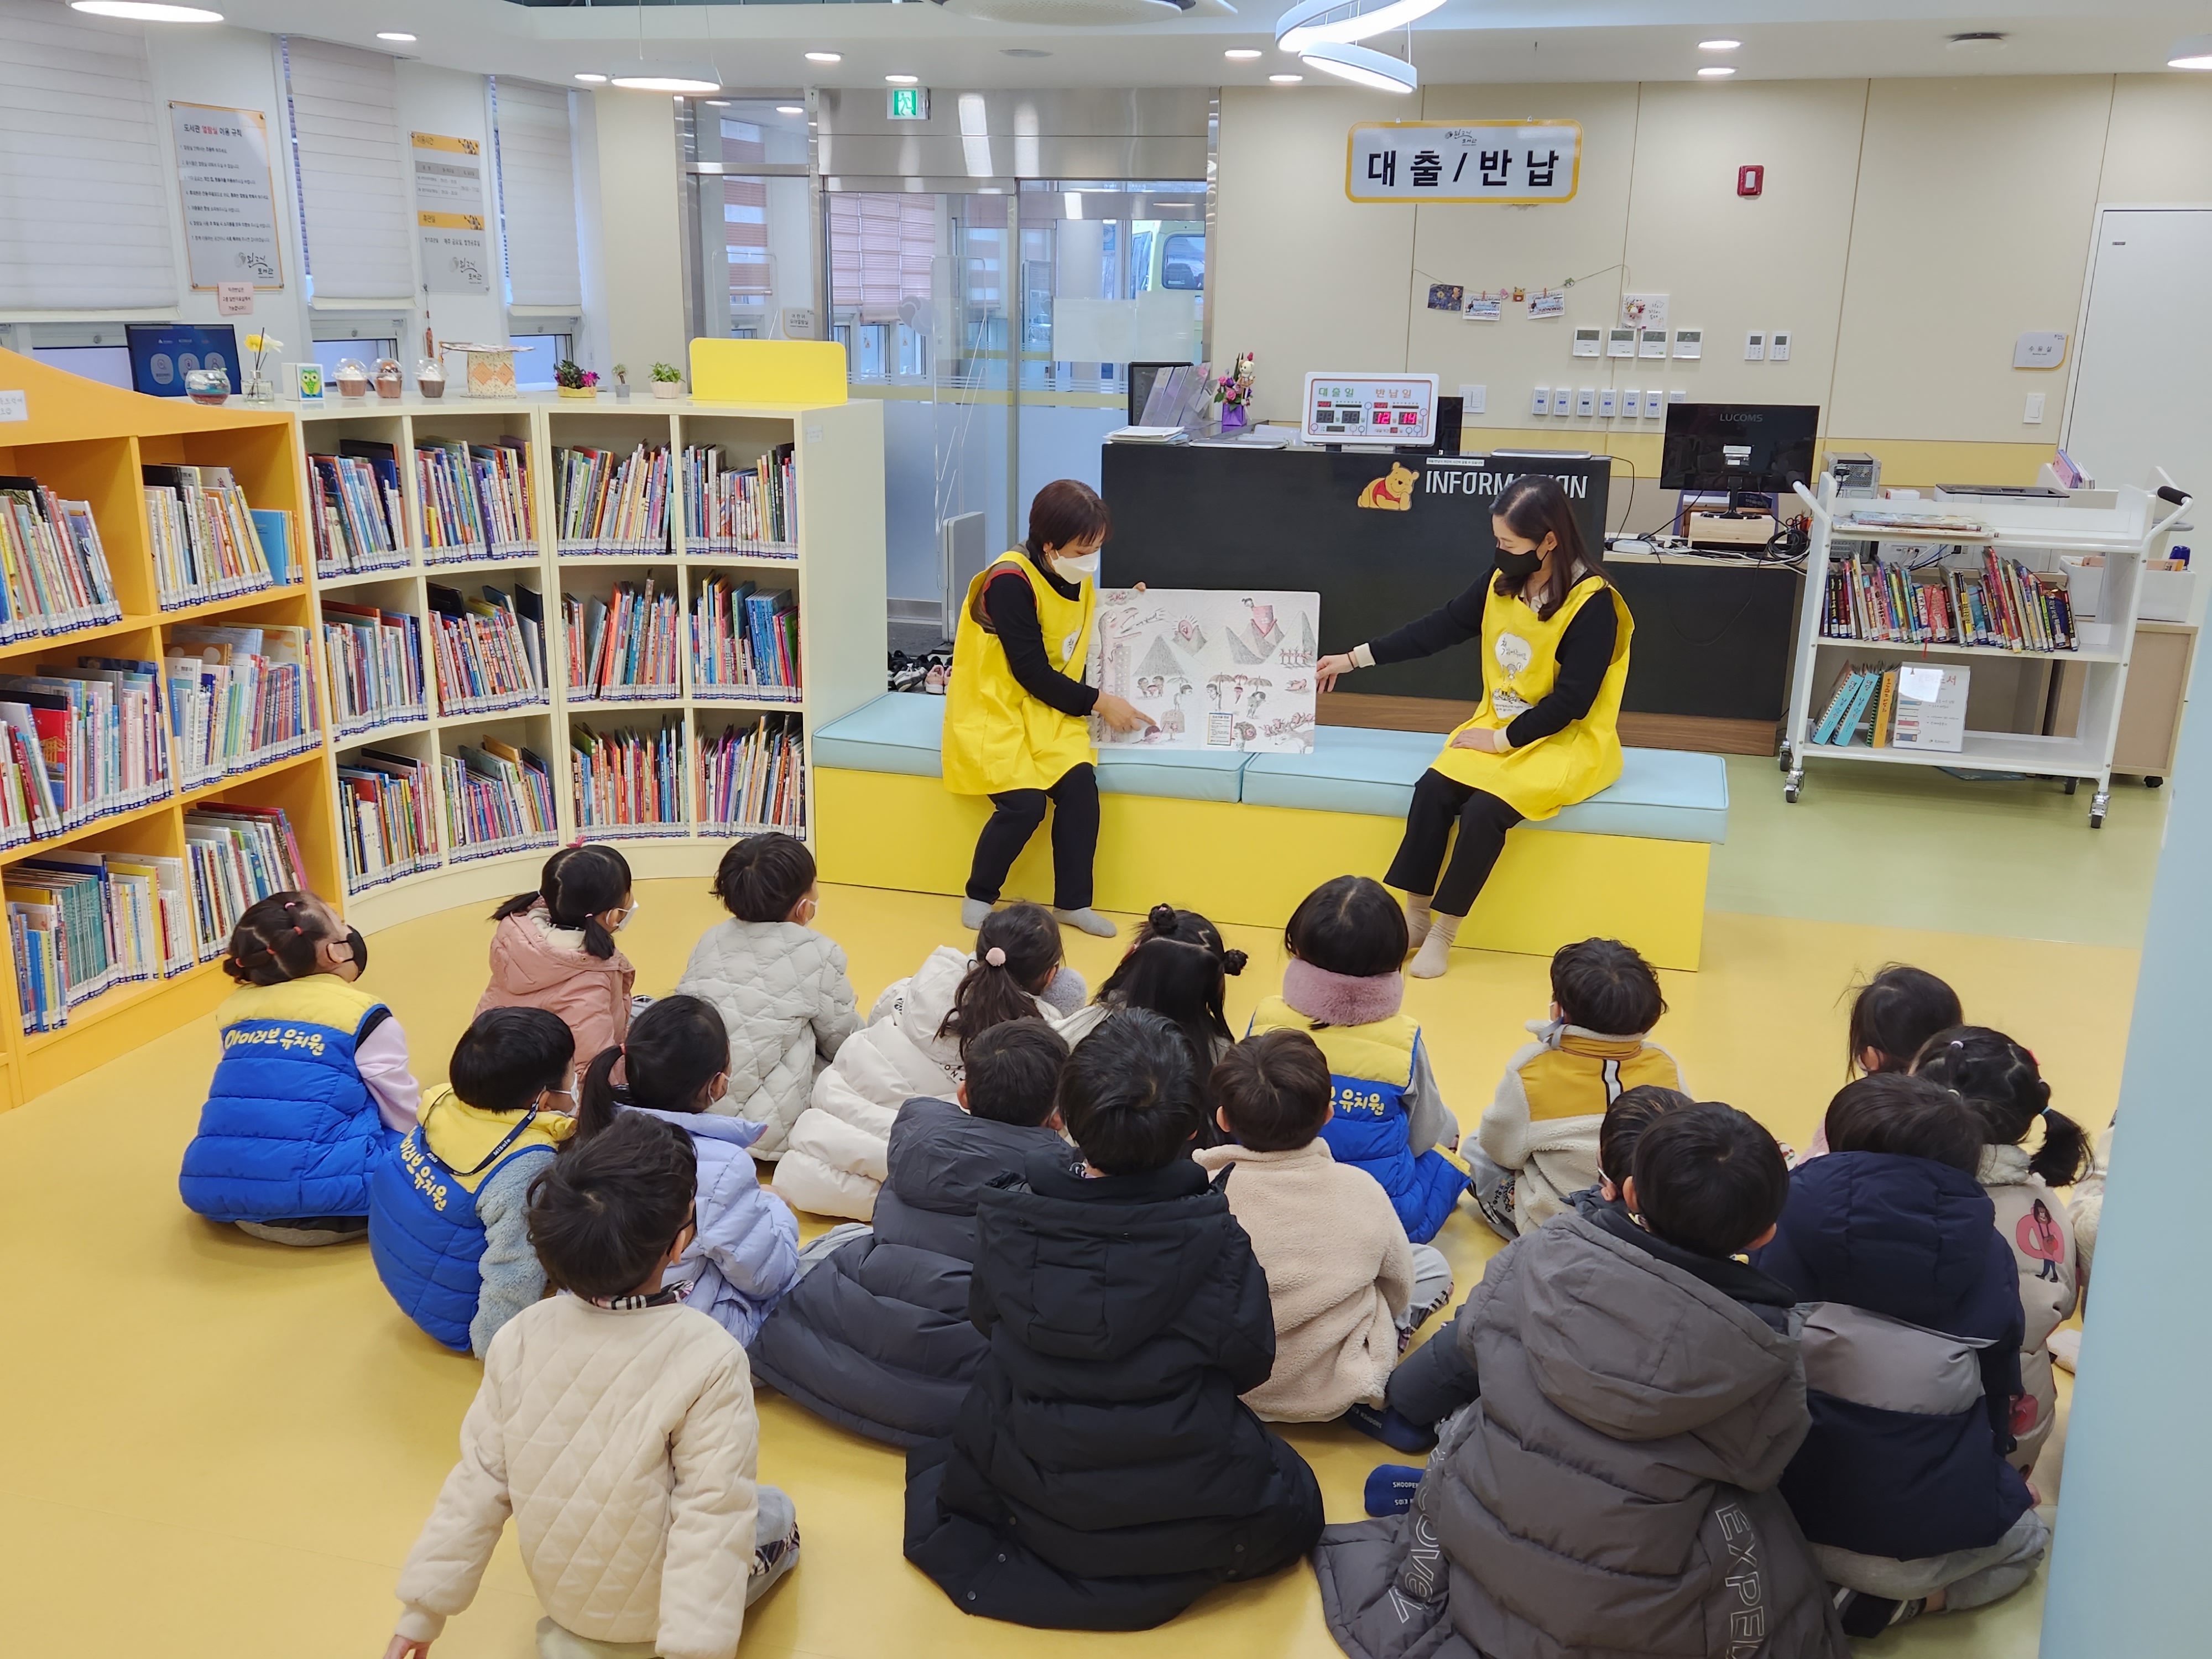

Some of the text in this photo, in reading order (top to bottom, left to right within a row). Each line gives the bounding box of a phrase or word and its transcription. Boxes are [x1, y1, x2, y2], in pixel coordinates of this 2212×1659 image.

[184, 124, 200, 133] 도서관
[219, 128, 230, 137] 이용
[1368, 149, 1559, 187] 대출/반납
[1377, 411, 1391, 424] 12
[1720, 413, 1764, 422] LUCOMS
[279, 1029, 326, 1056] 유치원
[1339, 1089, 1385, 1117] 유치원
[414, 1165, 447, 1212] 유치원
